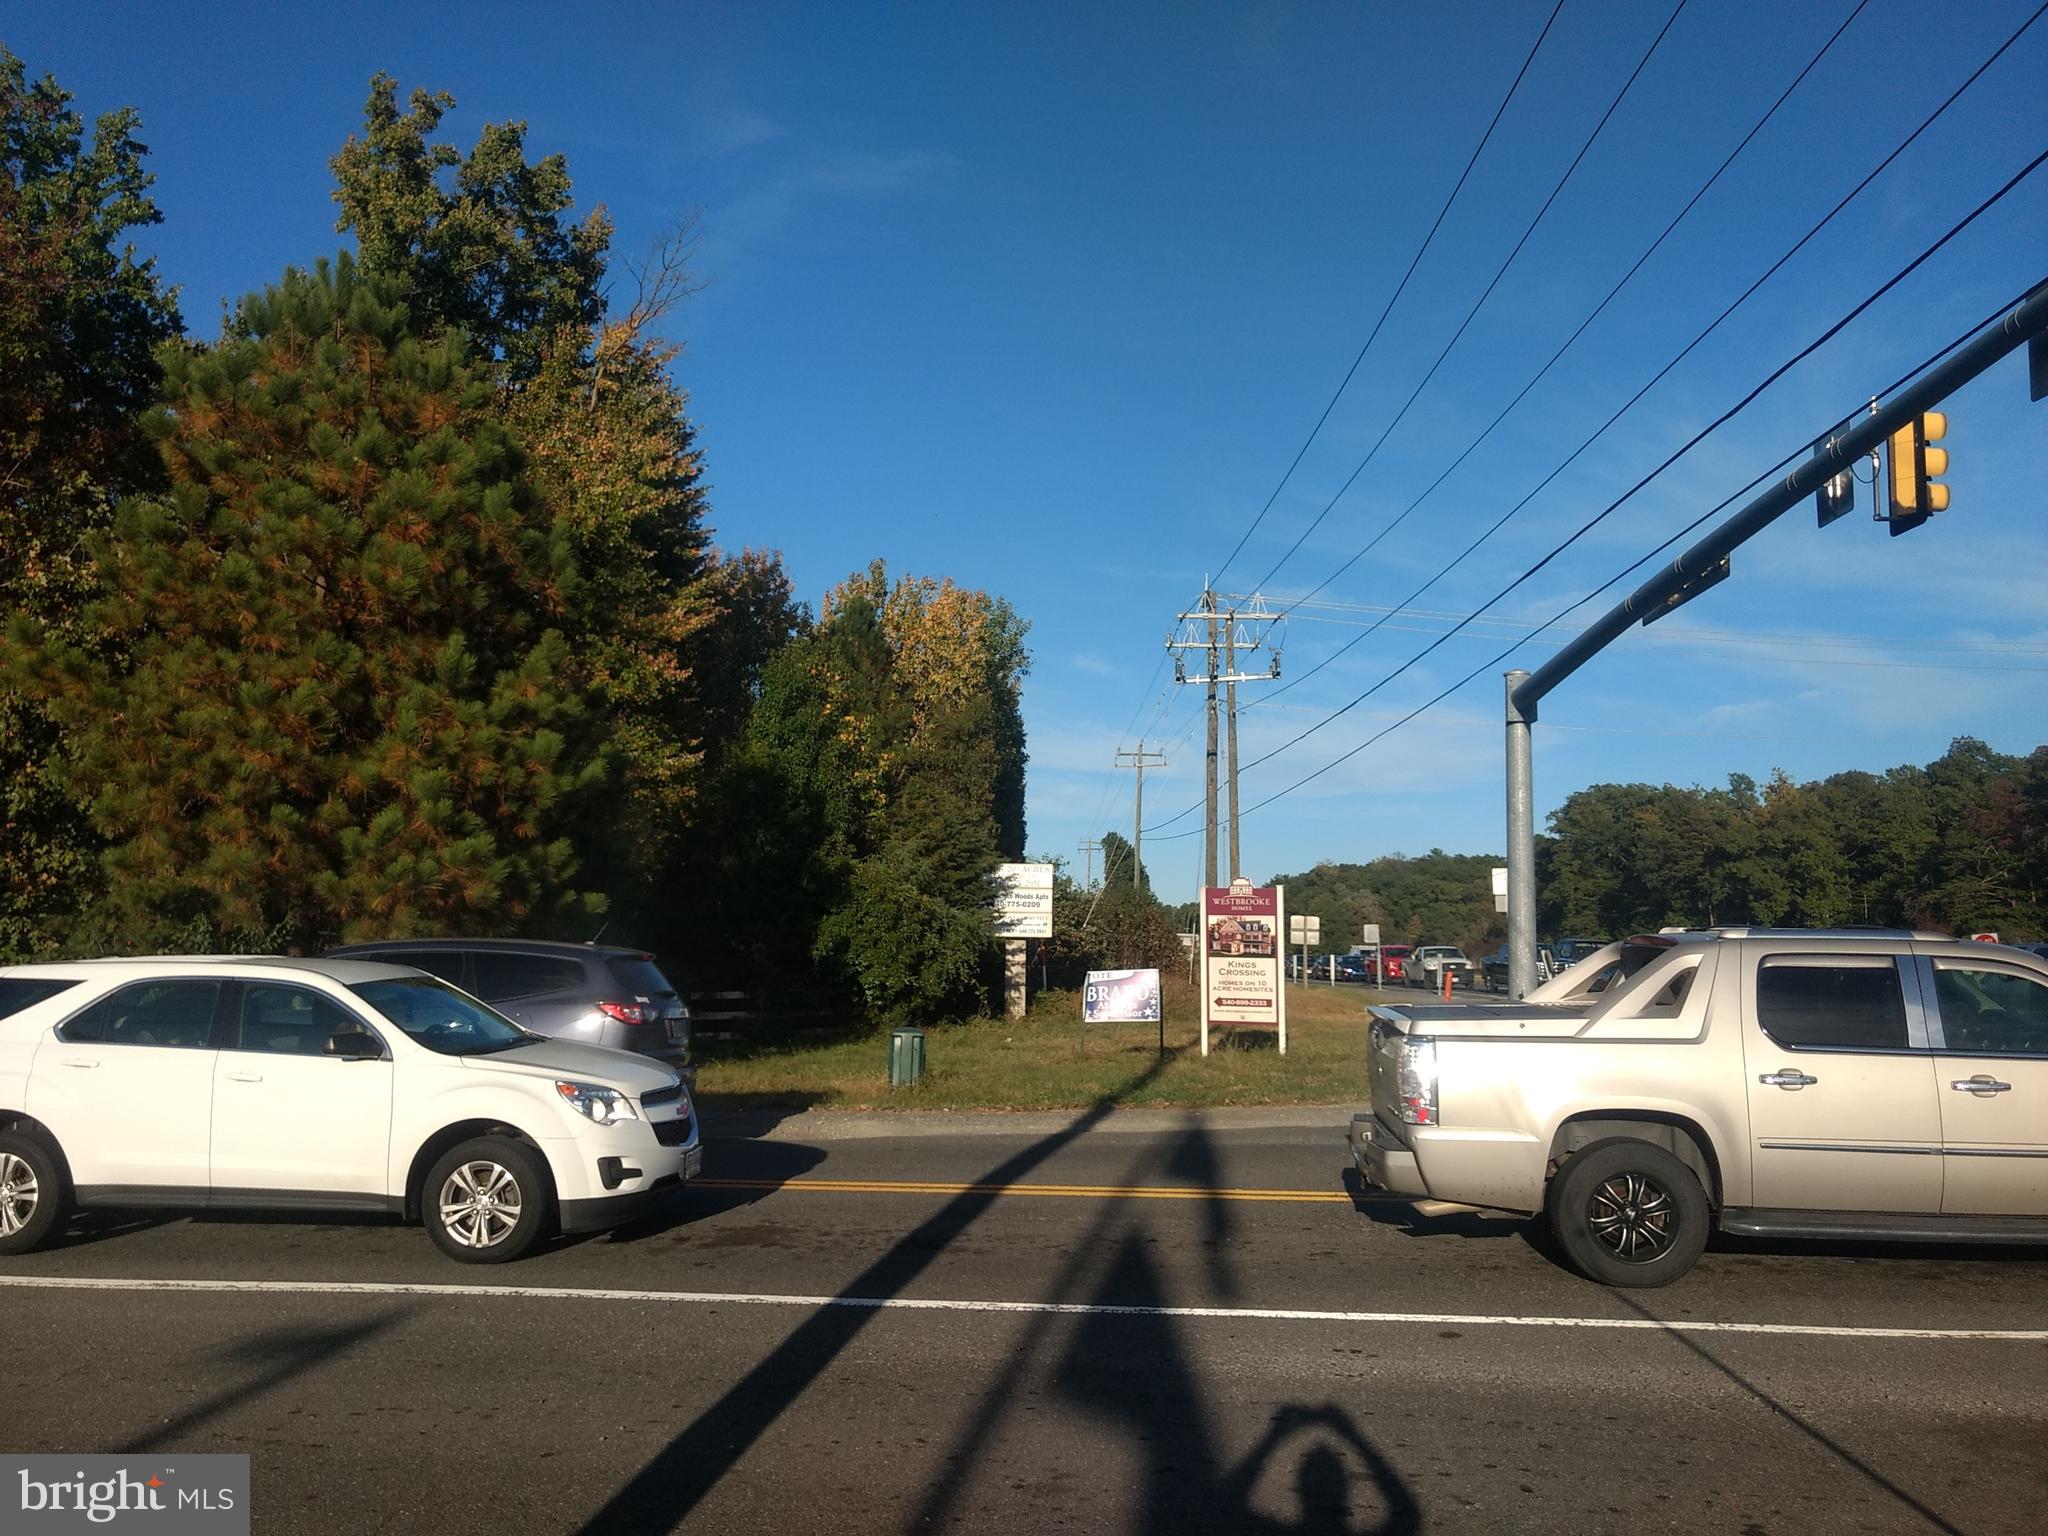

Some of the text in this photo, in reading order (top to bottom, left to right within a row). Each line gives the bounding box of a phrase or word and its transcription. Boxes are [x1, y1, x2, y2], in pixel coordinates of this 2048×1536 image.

[1035, 893, 1049, 901] Apts
[1212, 897, 1271, 905] WESTBROOKE
[1227, 960, 1257, 969] KINGS
[1218, 968, 1267, 976] CROSSING
